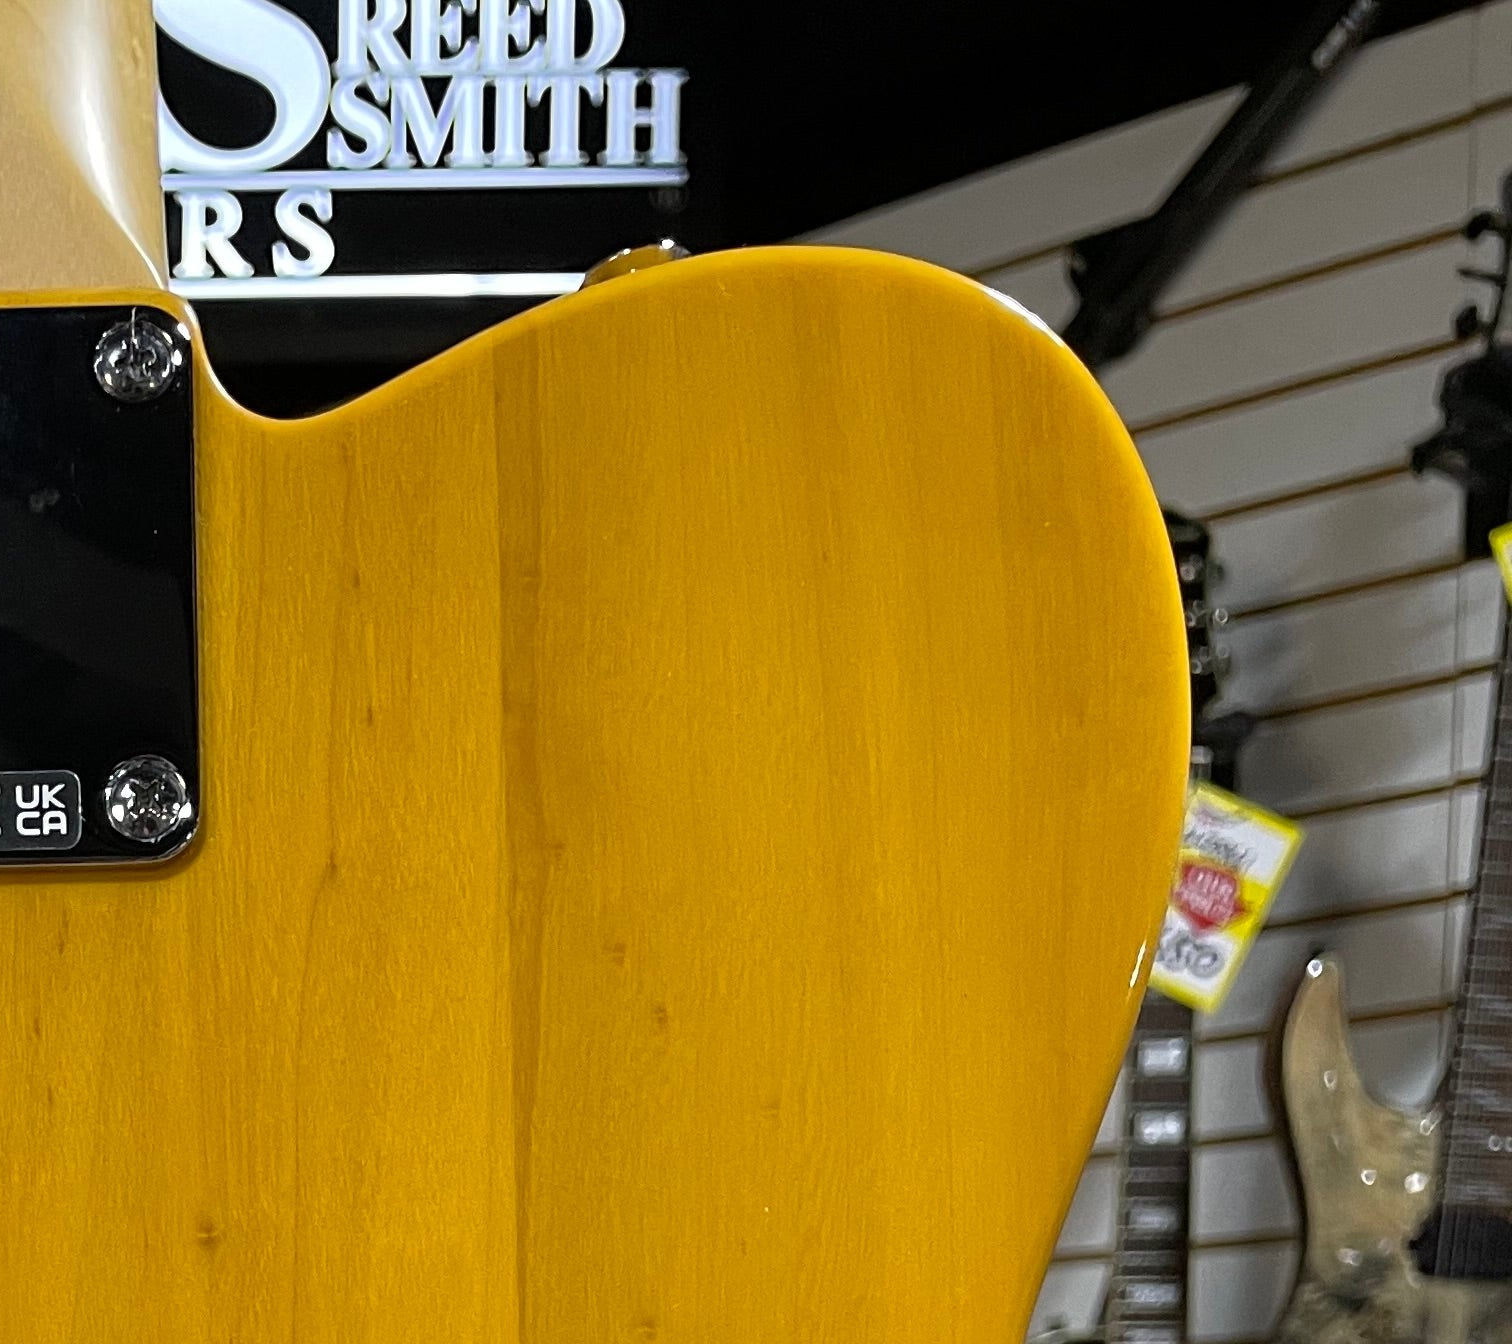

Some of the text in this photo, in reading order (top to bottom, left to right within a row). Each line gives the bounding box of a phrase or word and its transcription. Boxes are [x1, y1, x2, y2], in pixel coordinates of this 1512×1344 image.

[334, 0, 626, 72] REED
[327, 70, 687, 168] SMITH
[16, 784, 65, 808] UK
[16, 811, 67, 836] CA
